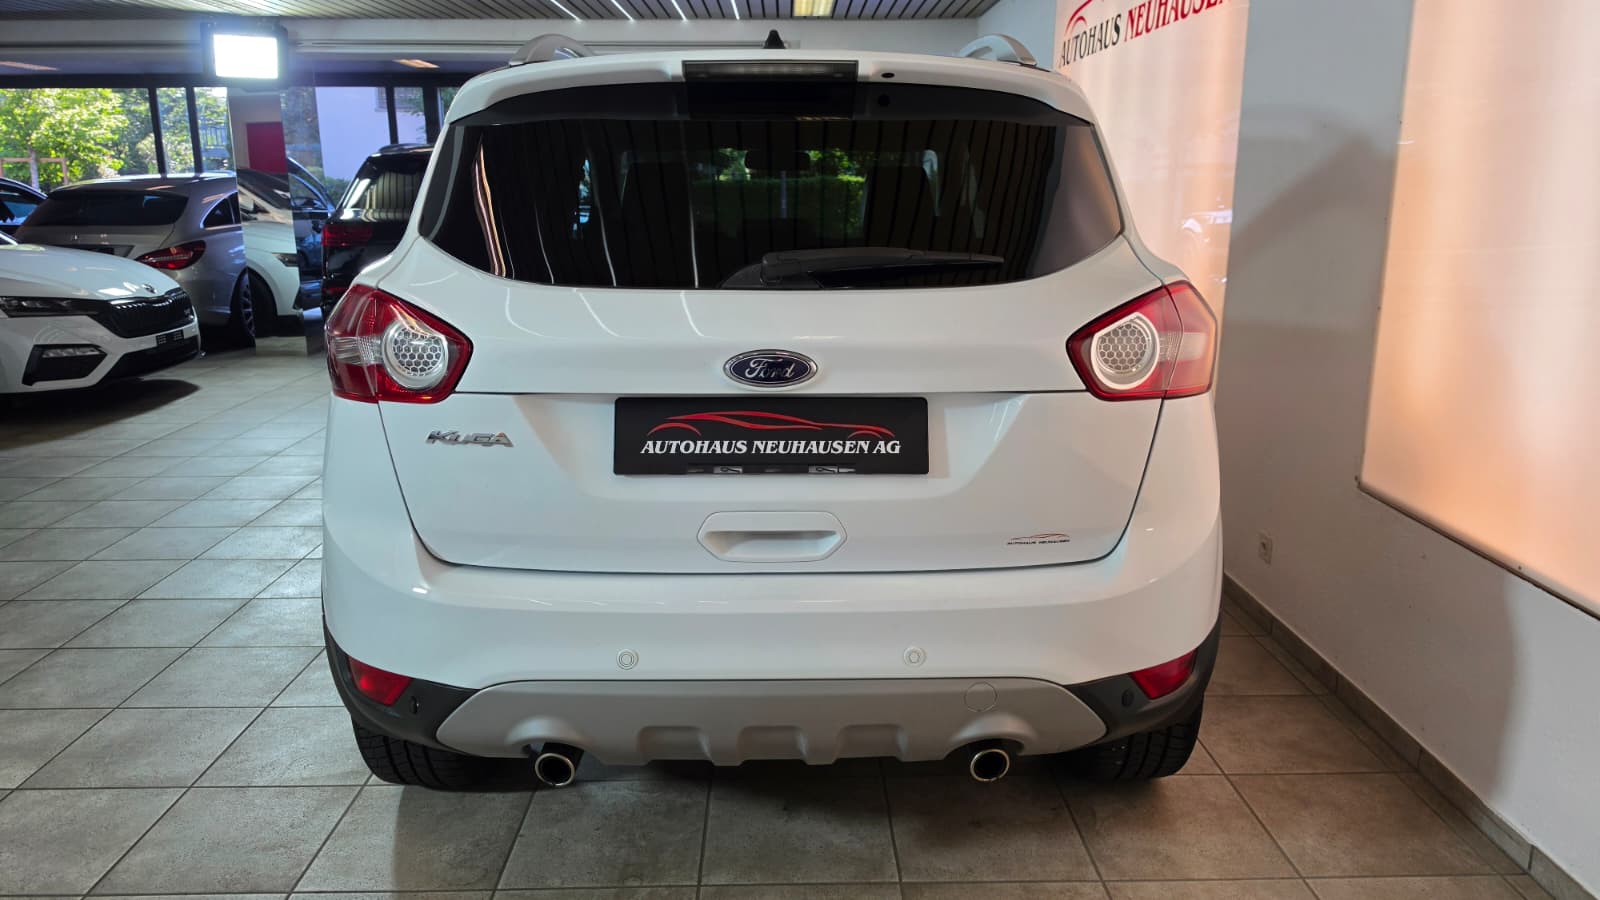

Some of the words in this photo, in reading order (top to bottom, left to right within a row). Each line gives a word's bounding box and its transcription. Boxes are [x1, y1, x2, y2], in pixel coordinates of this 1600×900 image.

[1058, 13, 1122, 68] AUTOHAUS
[1124, 0, 1226, 42] NEUHAU
[744, 358, 796, 378] Ford
[640, 440, 748, 454] AUTOHAUS
[751, 440, 870, 454] NEUHAUSEN
[872, 440, 901, 454] AG
